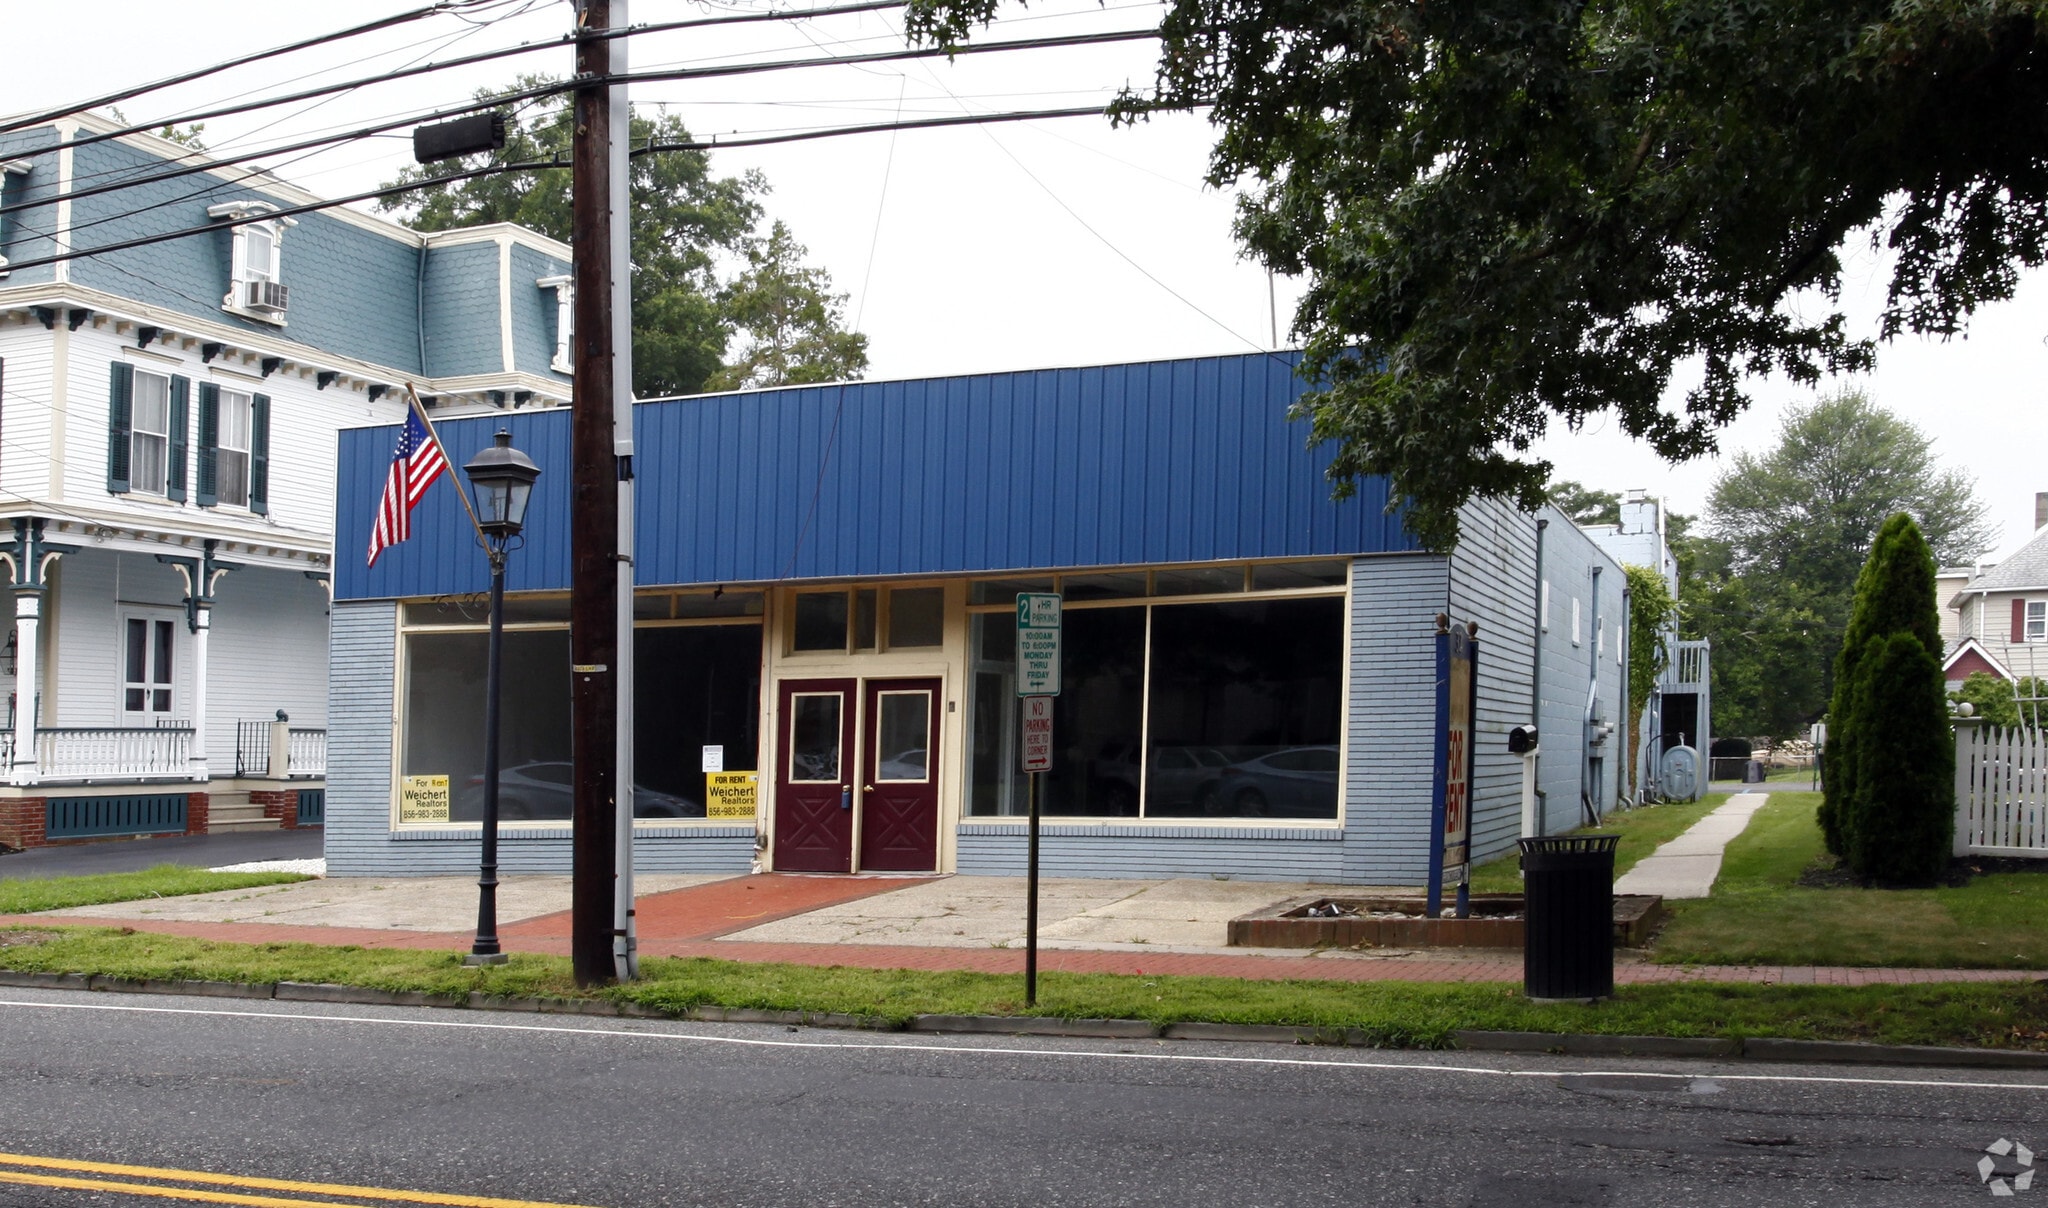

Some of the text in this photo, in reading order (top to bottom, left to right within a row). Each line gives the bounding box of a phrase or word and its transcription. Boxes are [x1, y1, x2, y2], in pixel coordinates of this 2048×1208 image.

[1020, 599, 1052, 623] 2 HR
[1032, 613, 1058, 623] PARKING
[1025, 632, 1053, 640] 10:00AM
[1022, 641, 1031, 650] TO
[1024, 652, 1053, 660] MONDAY
[1029, 662, 1048, 670] THRU
[1027, 671, 1050, 679] FRIDAY
[1032, 702, 1044, 716] NO
[1026, 719, 1050, 733] PARKING
[1027, 734, 1049, 744] HERE TO
[1028, 745, 1048, 756] CORNER
[416, 779, 428, 787] For
[714, 776, 746, 784] FOR RENT
[404, 790, 447, 800] Weichert
[709, 787, 755, 797] Weichert
[416, 800, 448, 808] Realtors
[721, 796, 755, 805] Realtors
[403, 809, 448, 819] 856-983-2888
[708, 807, 756, 816] 856-983-2888
